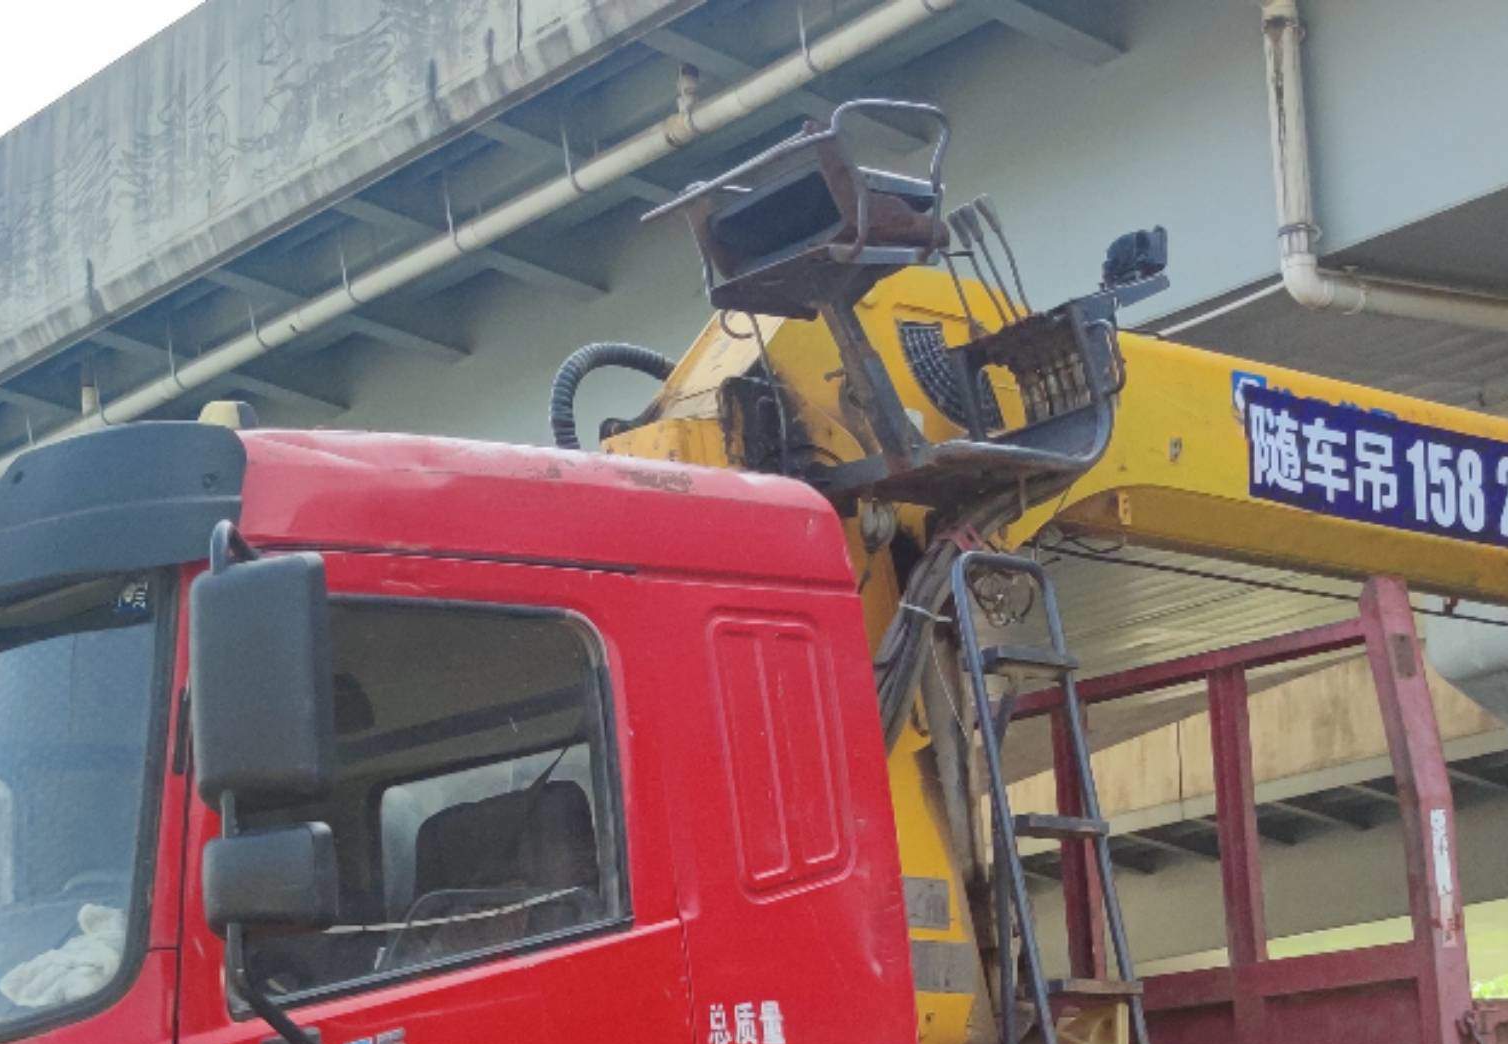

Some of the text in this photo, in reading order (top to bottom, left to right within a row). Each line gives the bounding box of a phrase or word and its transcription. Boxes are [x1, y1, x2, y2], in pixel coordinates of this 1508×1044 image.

[1250, 403, 1398, 512] 随车吊
[1406, 440, 1485, 533] 158
